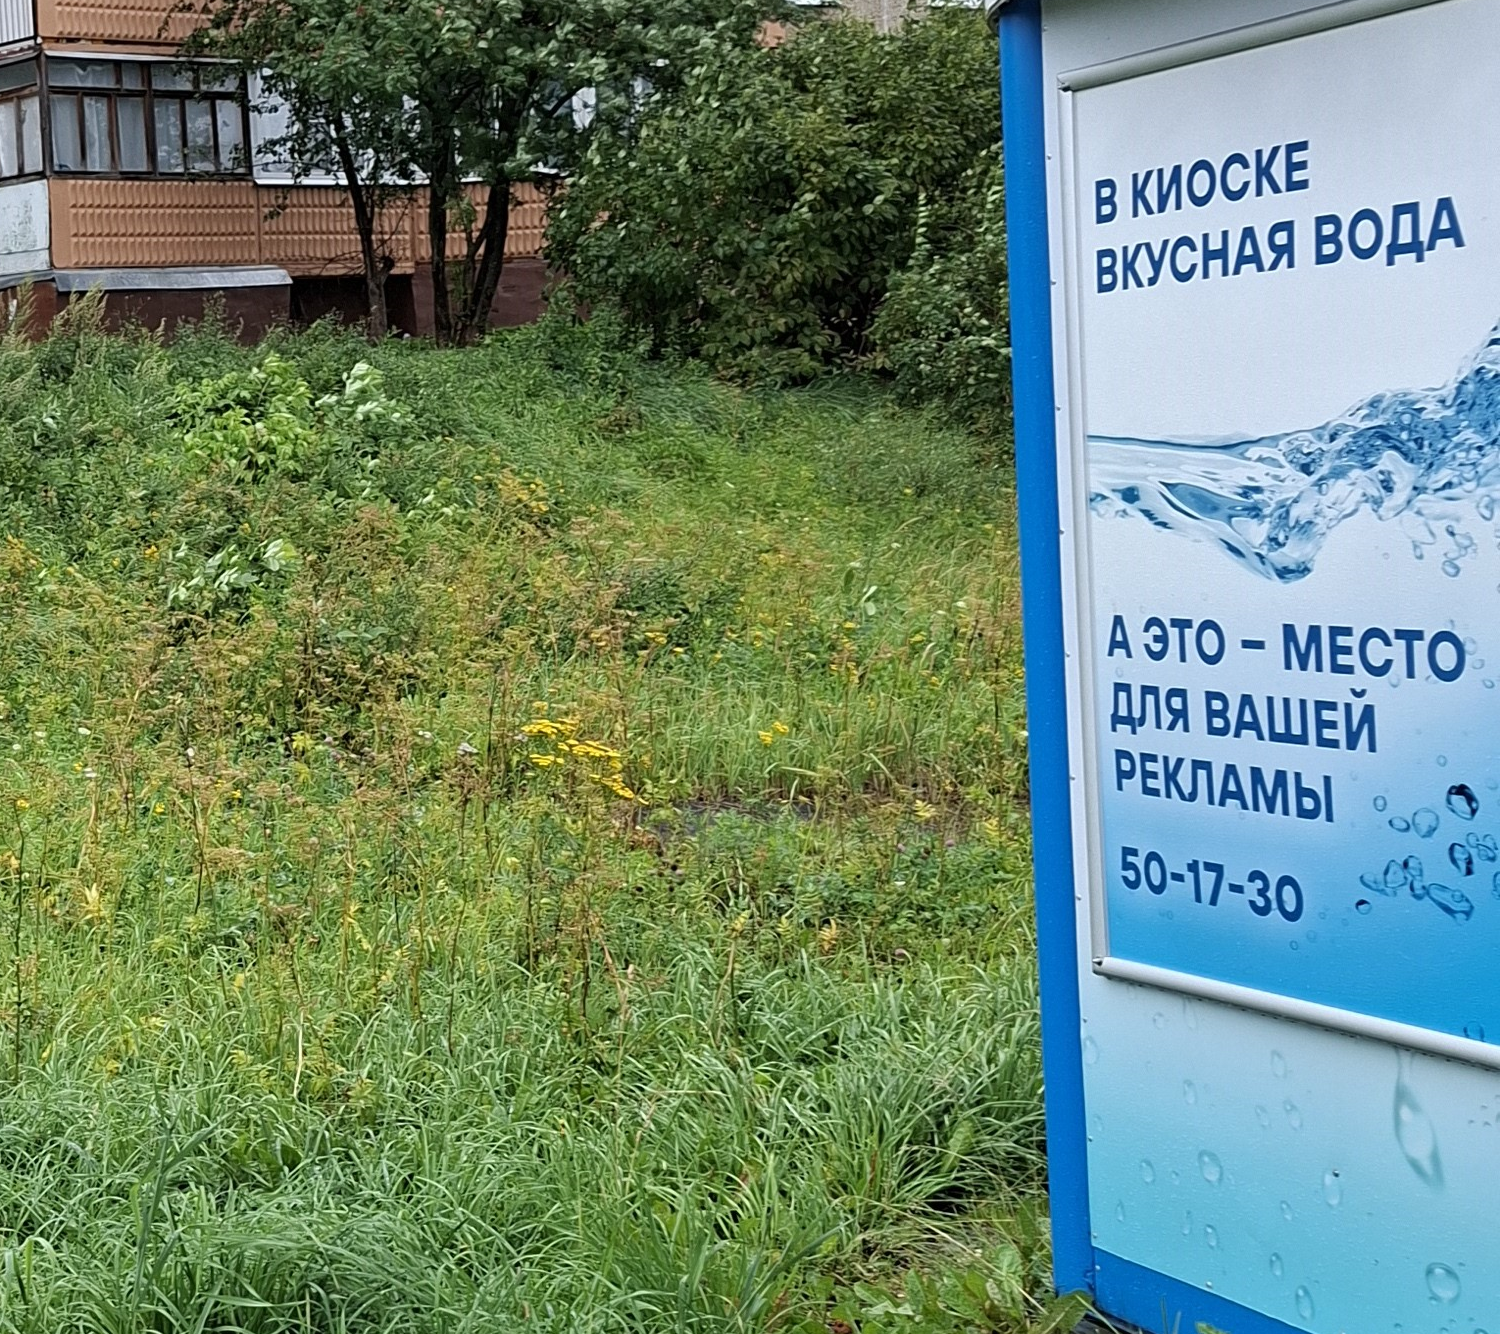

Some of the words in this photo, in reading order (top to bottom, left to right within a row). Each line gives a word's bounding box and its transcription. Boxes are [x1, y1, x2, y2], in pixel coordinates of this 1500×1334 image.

[1094, 178, 1118, 225] В
[1131, 140, 1311, 218] КИОСКЕ
[1096, 219, 1296, 294] ВКУСНАЯ
[1314, 196, 1467, 266] ВОДА
[1107, 614, 1133, 659] А
[1143, 616, 1226, 665] ЭТО
[1282, 623, 1466, 683] МЕСТО
[1110, 682, 1191, 735] ДЛЯ
[1204, 688, 1378, 753] ВАШЕЙ
[1114, 749, 1335, 823] РЕКЛАМЫ
[1120, 846, 1304, 923] 50-17-30
